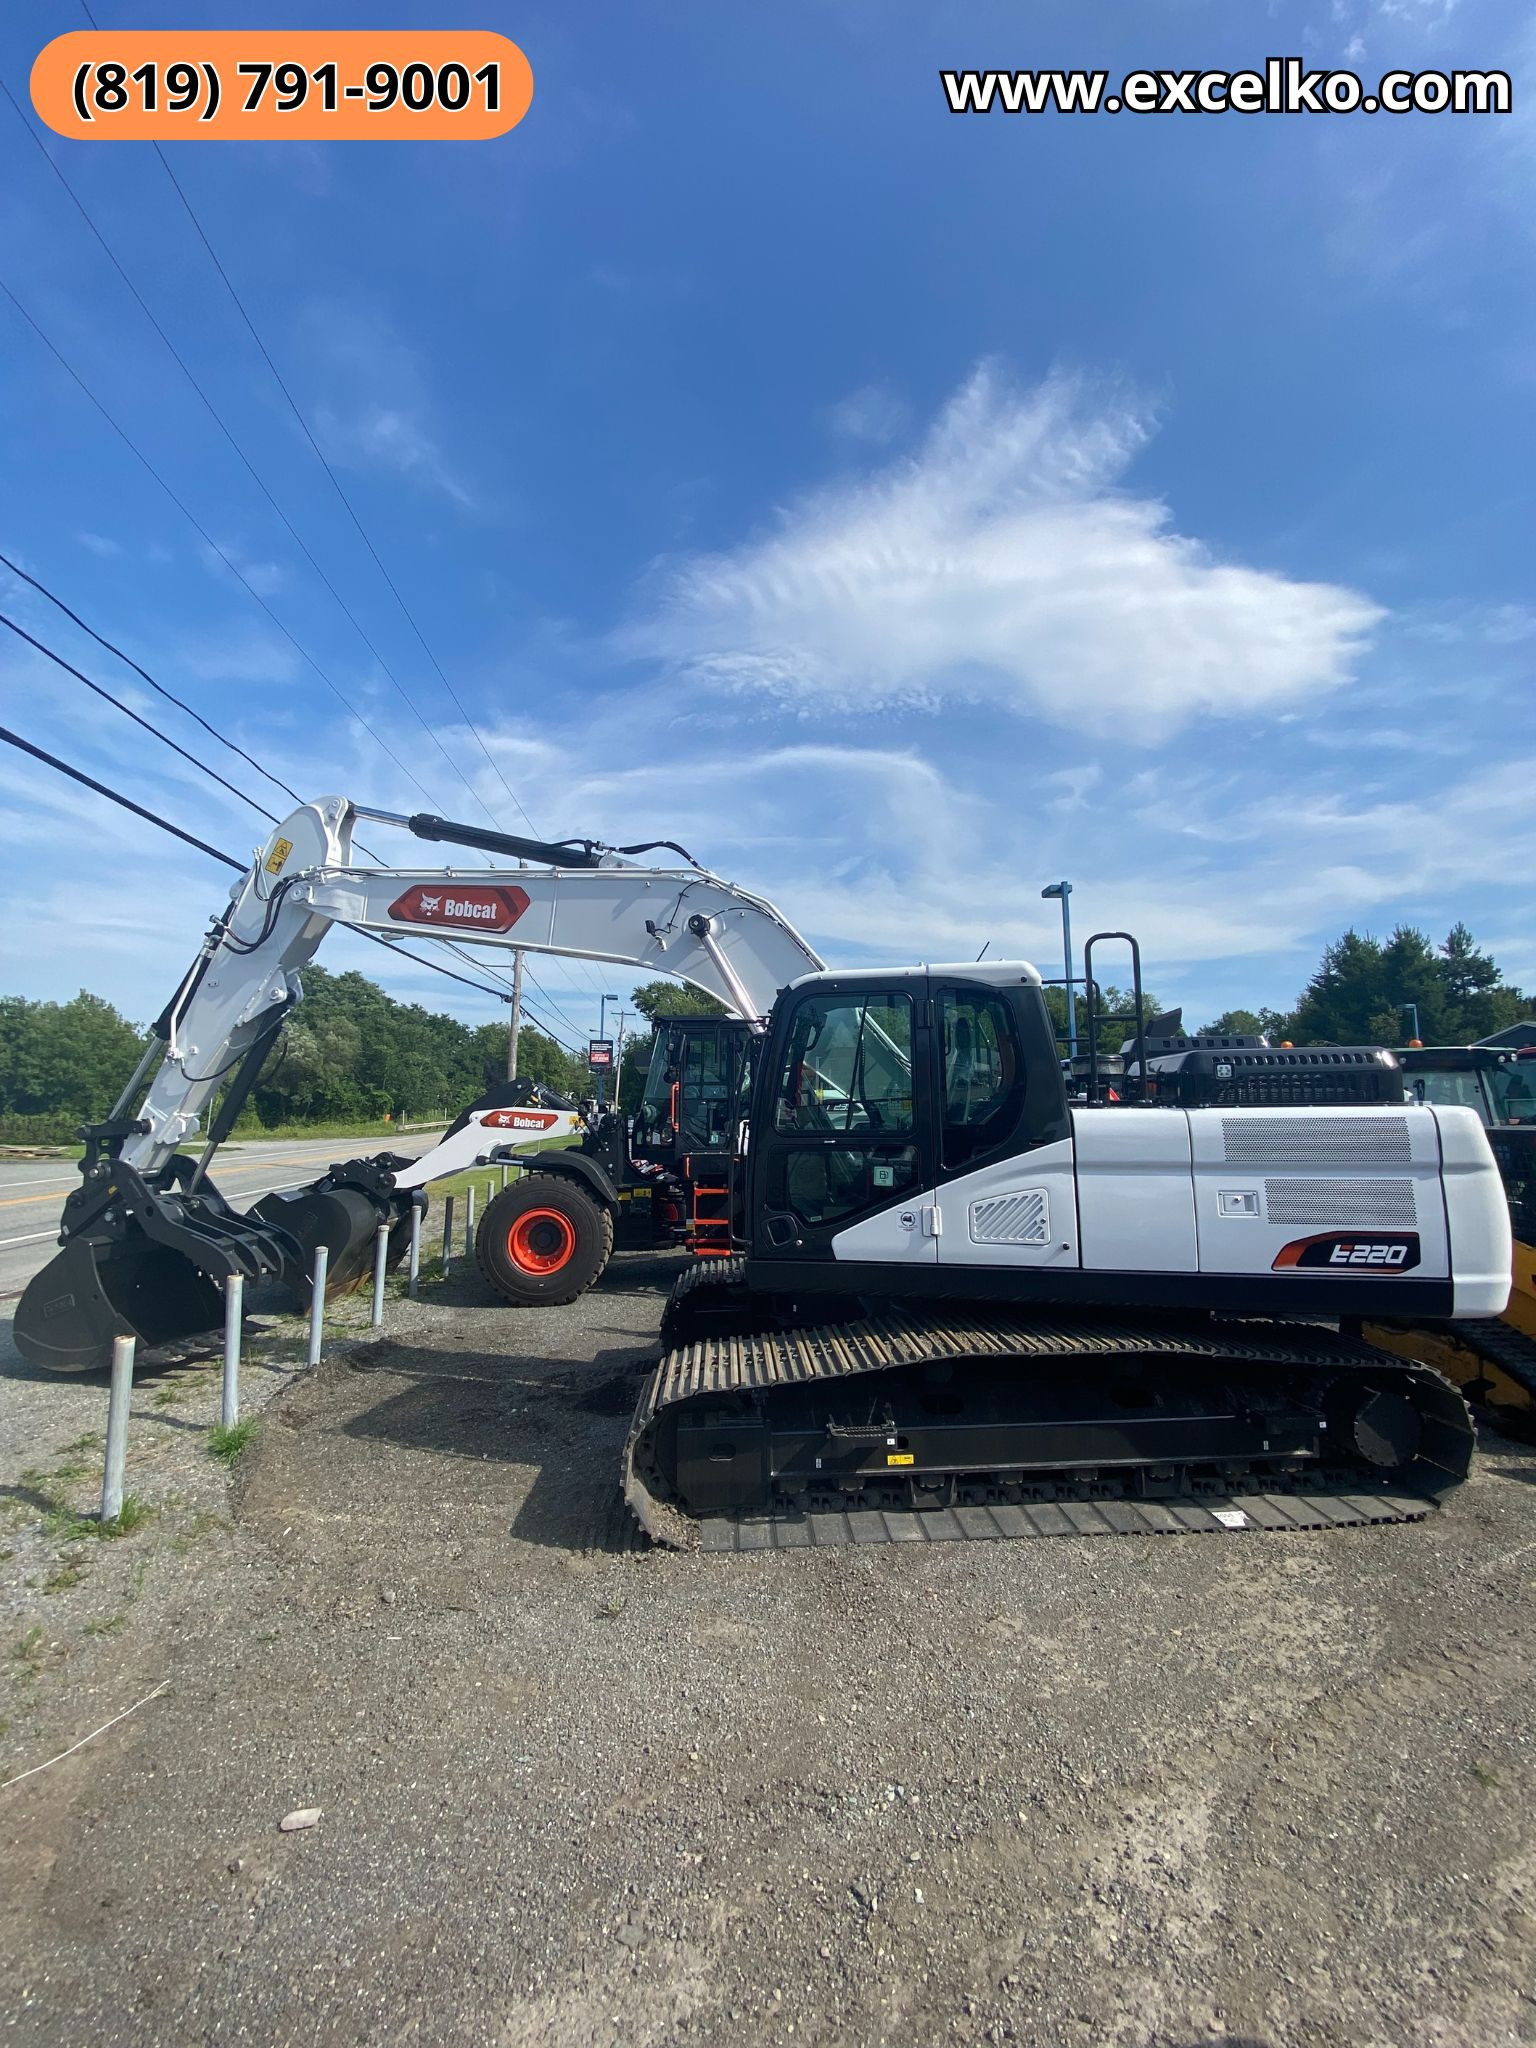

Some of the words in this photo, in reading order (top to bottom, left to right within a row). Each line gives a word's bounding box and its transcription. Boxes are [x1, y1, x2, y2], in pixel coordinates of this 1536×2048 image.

[444, 899, 497, 919] Bobcat
[513, 1117, 545, 1128] Bobcat
[1329, 1244, 1408, 1264] E220
